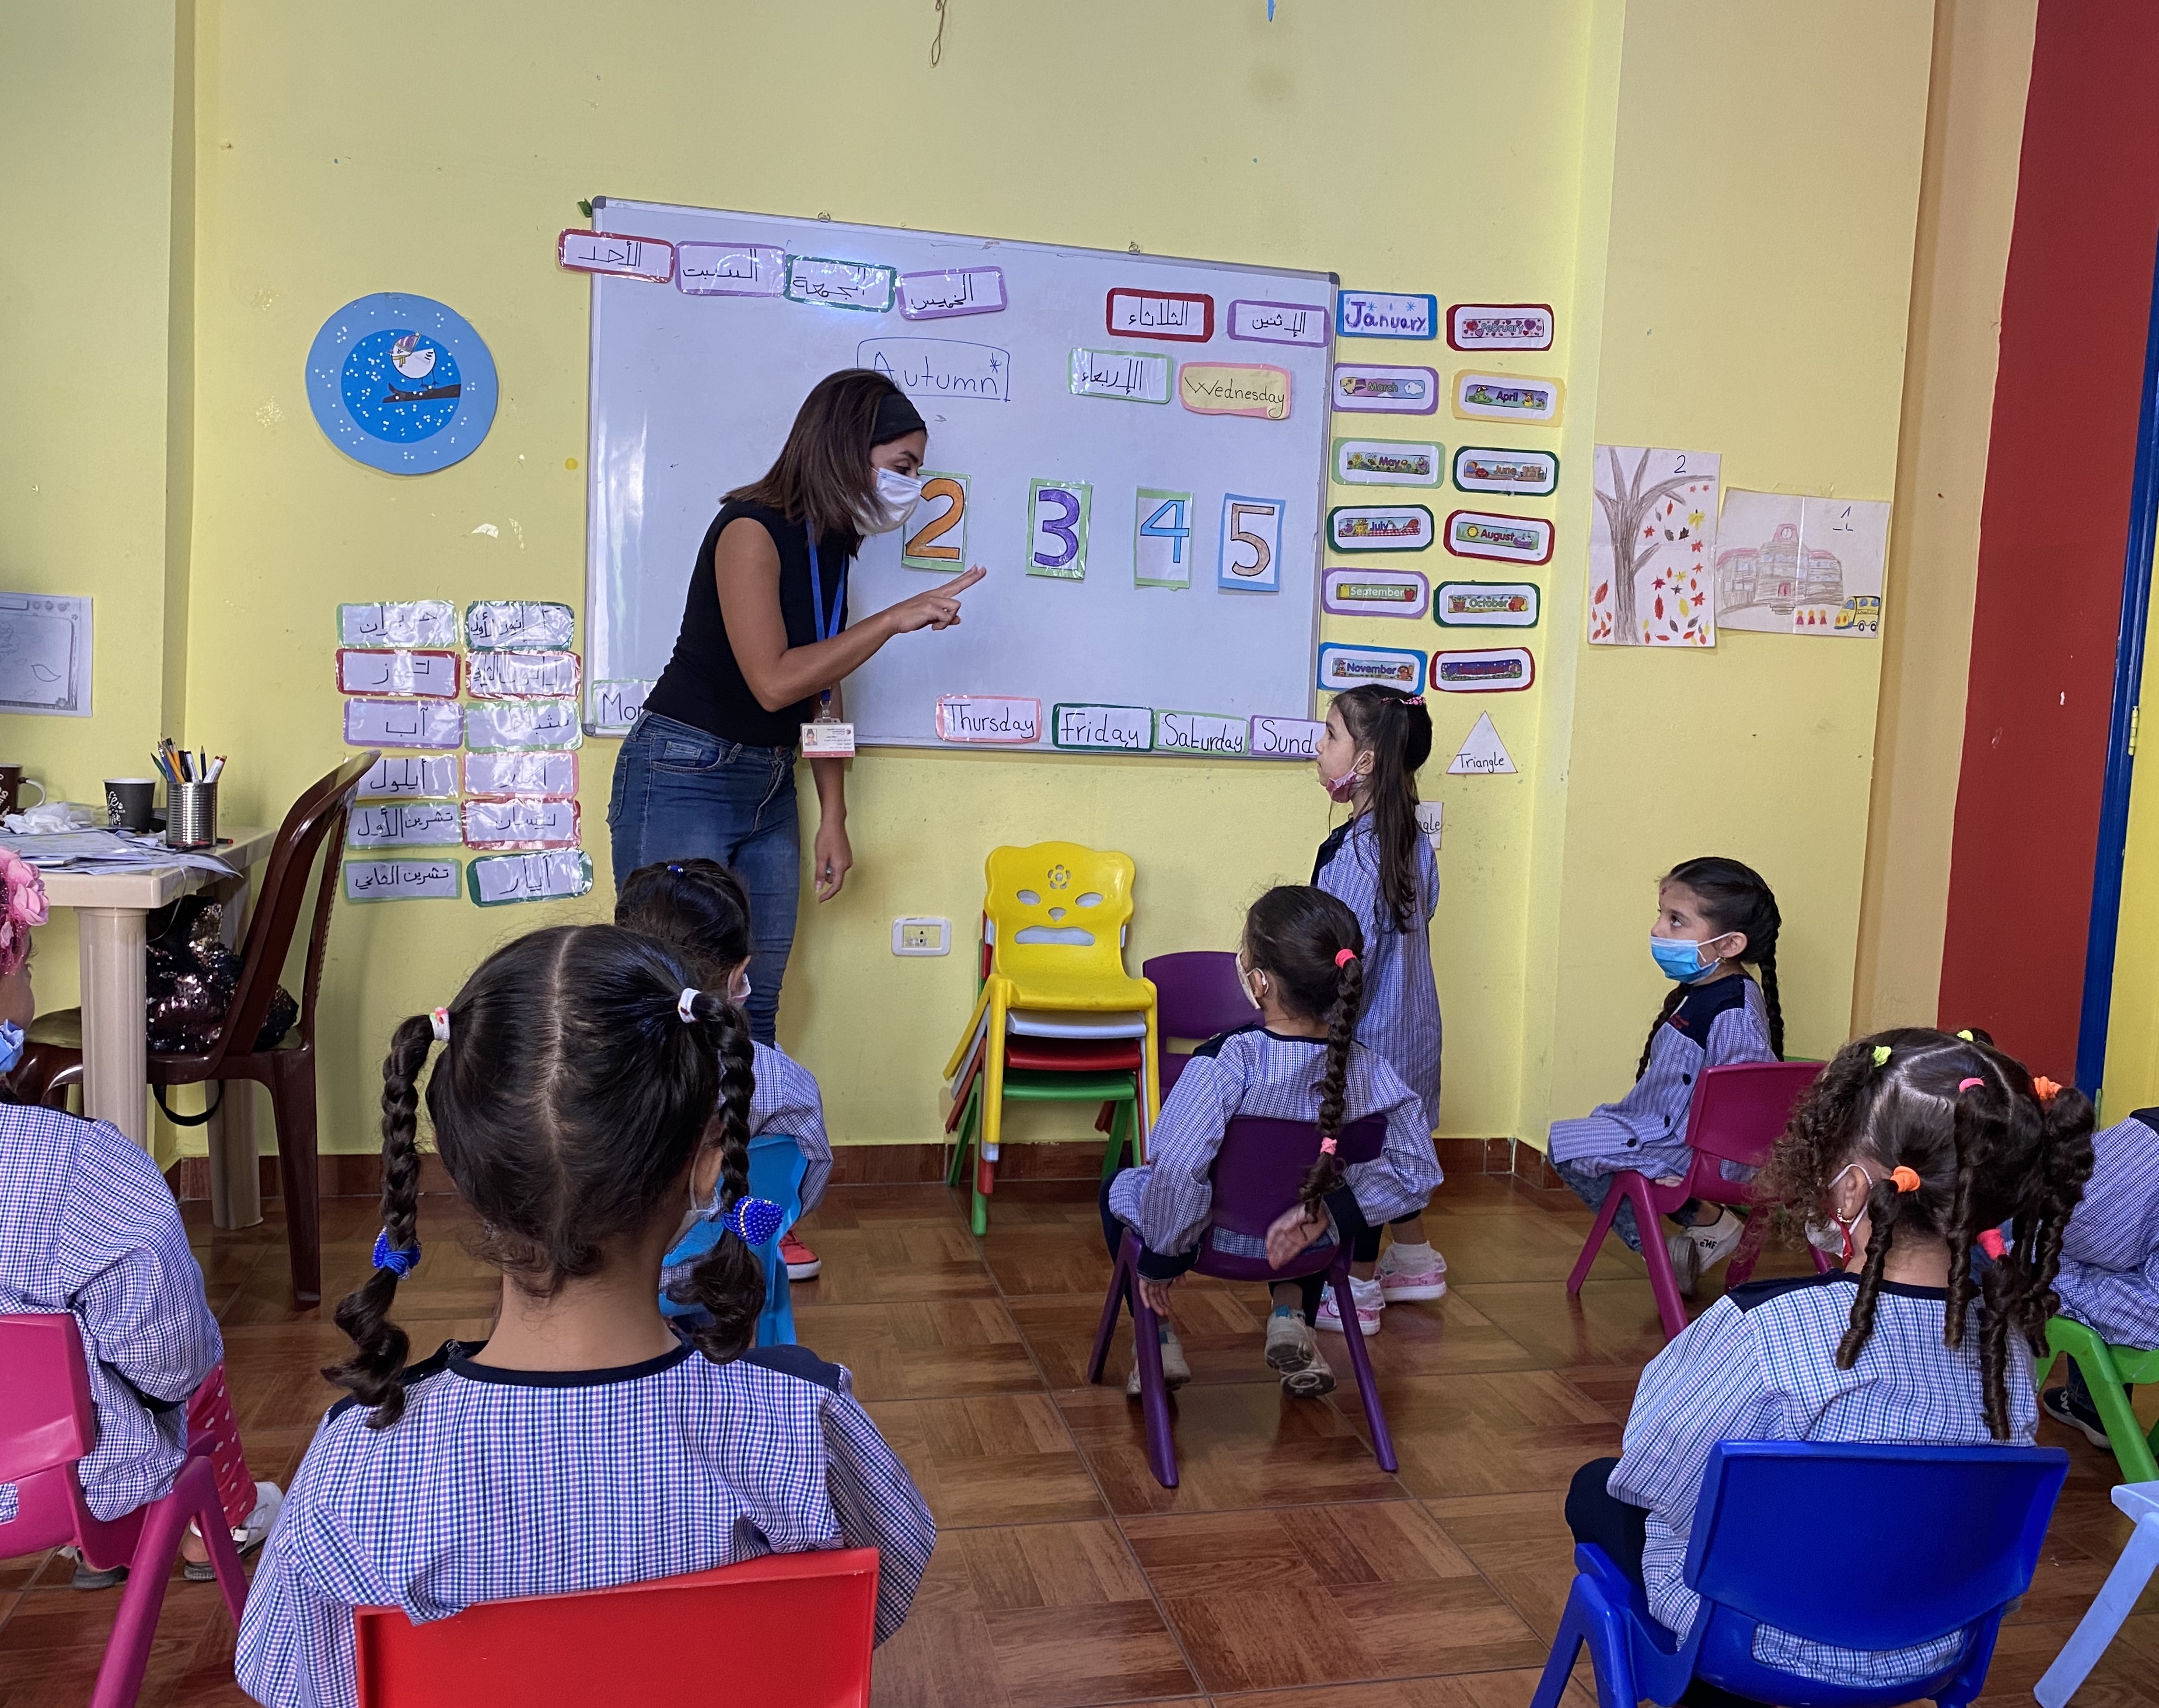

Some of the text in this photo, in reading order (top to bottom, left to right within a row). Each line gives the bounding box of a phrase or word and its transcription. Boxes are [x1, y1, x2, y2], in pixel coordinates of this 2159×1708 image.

[578, 240, 642, 267] الأحد
[682, 248, 758, 282] السبت
[792, 267, 867, 301] الجمعة
[911, 273, 974, 310] الخميس
[1128, 296, 1189, 327] الثلاثاء
[1344, 301, 1427, 332] January
[1480, 322, 1525, 334] February
[874, 351, 998, 395] Autumn
[1367, 381, 1399, 393] March
[1184, 376, 1285, 419] Wednesday
[1496, 390, 1519, 403] April
[1378, 456, 1400, 468] May
[1494, 464, 1517, 476] June
[1674, 454, 1686, 474] 2
[905, 477, 965, 560] 2
[1033, 488, 1080, 567] 3
[1140, 499, 1190, 564] 4
[1370, 520, 1389, 532] July
[1230, 502, 1275, 577] 5
[1480, 528, 1516, 542] August
[1350, 586, 1405, 598] September
[1469, 596, 1509, 609] October
[1346, 662, 1398, 675] November
[385, 706, 429, 737] آب
[938, 703, 1035, 739] Thursday
[1061, 712, 1139, 749] Friday
[1164, 713, 1243, 753] Saturday
[1262, 719, 1314, 754] Sund
[370, 758, 427, 792] أيلول
[1456, 752, 1504, 774] Triangle
[357, 808, 453, 838] تشرين الأول
[355, 865, 449, 890] تشرين الثاني
